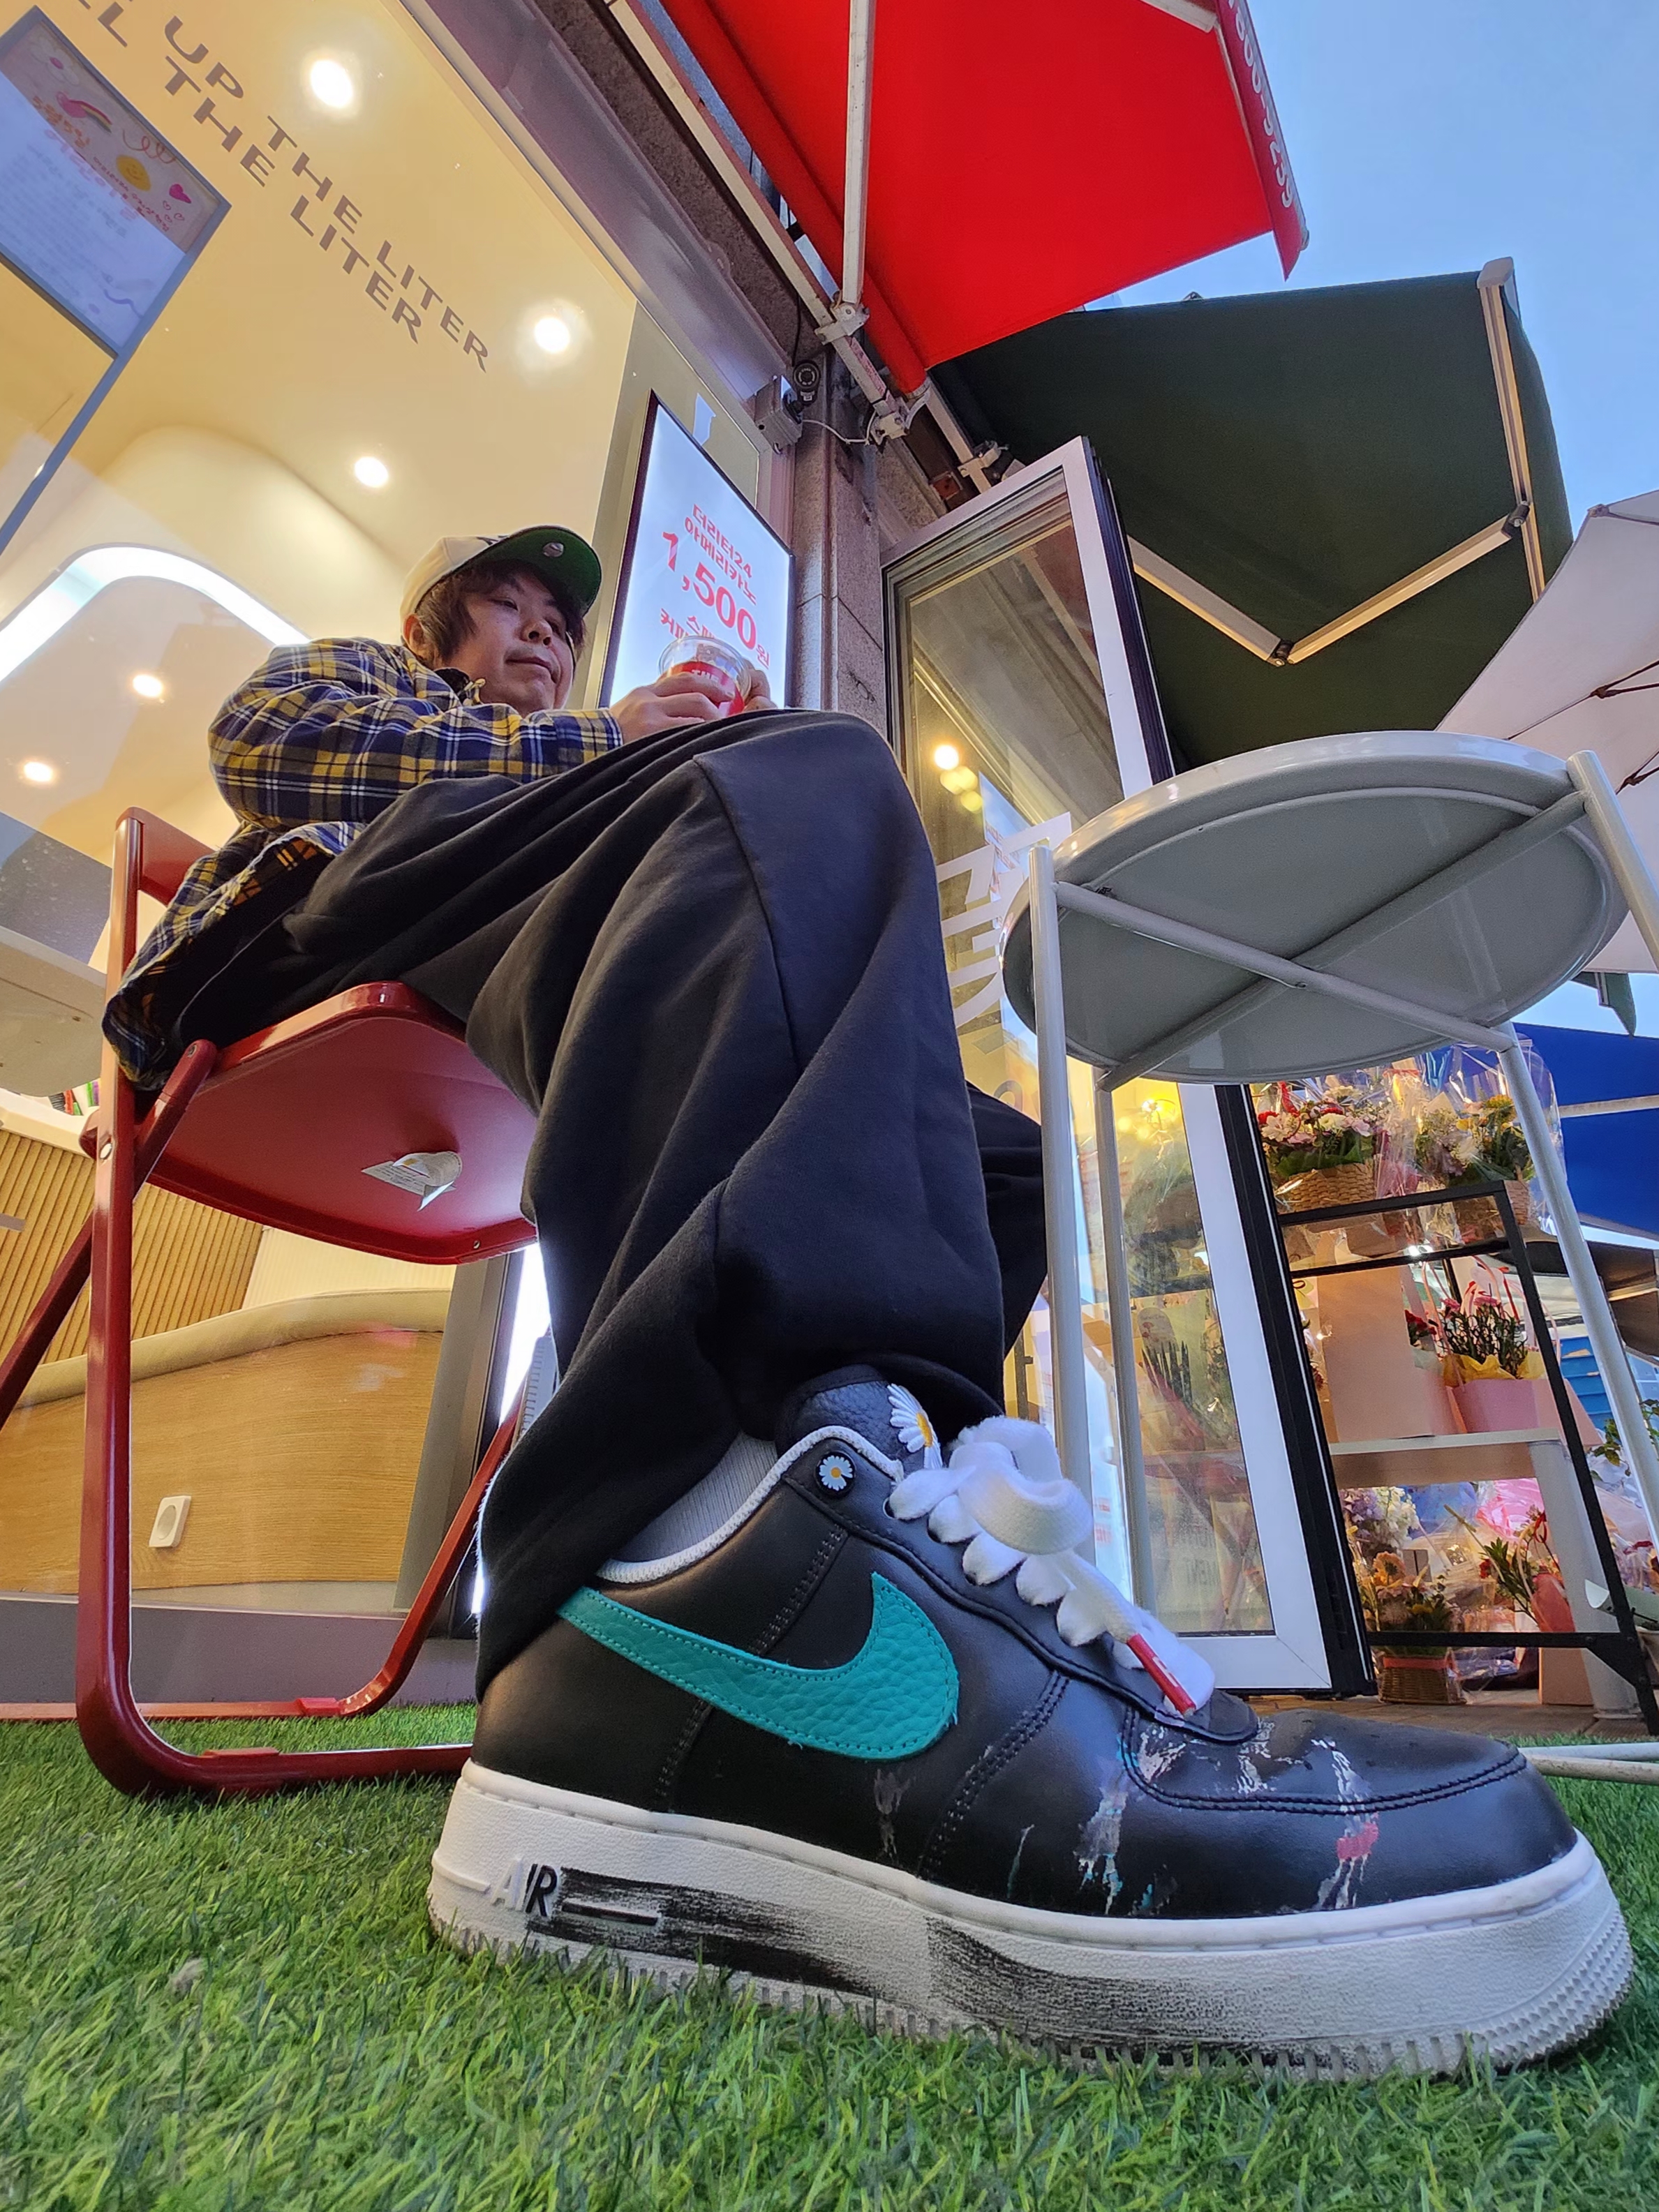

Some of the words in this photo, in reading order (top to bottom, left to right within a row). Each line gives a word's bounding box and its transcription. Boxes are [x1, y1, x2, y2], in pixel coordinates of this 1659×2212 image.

[164, 15, 244, 99] UP
[267, 115, 363, 234] THE
[376, 240, 489, 373] LITER
[164, 55, 276, 188] THE
[290, 194, 422, 344] LITER
[684, 516, 757, 606] 아메리카노
[692, 503, 753, 579] 더리터24
[491, 1858, 557, 1917] AIR
